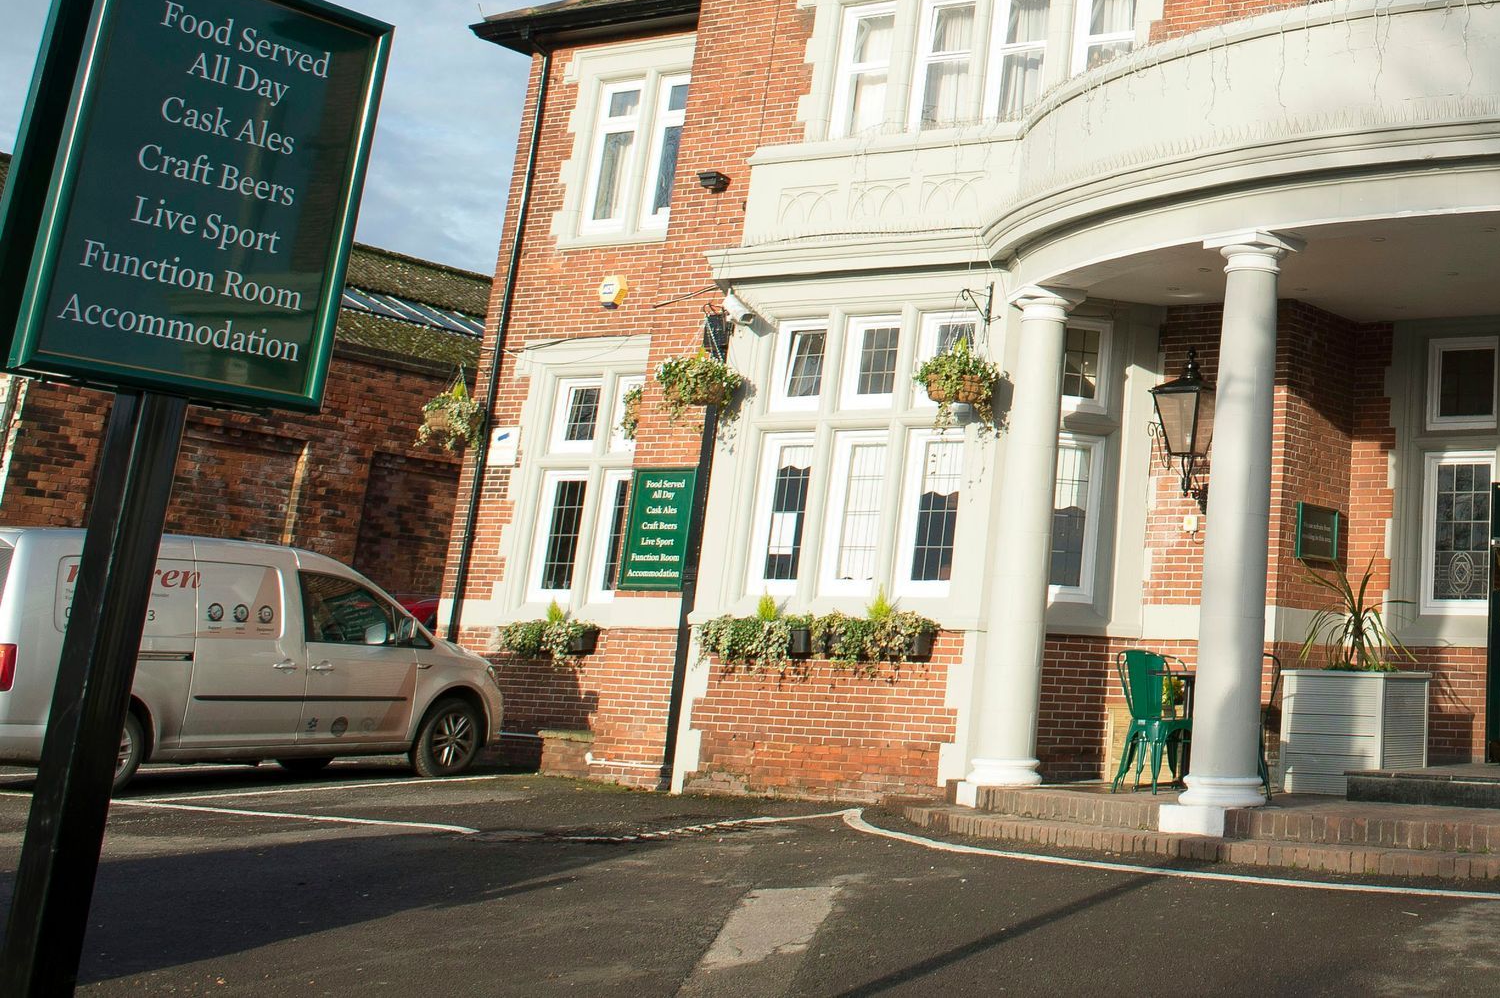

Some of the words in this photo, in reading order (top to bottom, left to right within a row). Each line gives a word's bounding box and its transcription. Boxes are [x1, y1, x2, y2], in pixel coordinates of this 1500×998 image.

[160, 0, 234, 46] Food
[239, 27, 331, 78] Served
[187, 52, 230, 85] All
[234, 64, 290, 107] Day
[161, 96, 232, 138] Cask
[234, 119, 295, 155] Ales
[138, 144, 214, 185] Craft
[217, 163, 295, 206] Beers
[131, 195, 196, 234] Live
[203, 213, 280, 254] Sport
[79, 239, 214, 292] Function
[220, 270, 302, 311] Room
[57, 293, 300, 362] Accommodation
[646, 480, 662, 488] Food
[663, 479, 686, 488] Served
[652, 490, 662, 499] All
[662, 490, 675, 500] Day
[641, 521, 659, 530] Craft
[659, 521, 678, 530] Beers
[646, 506, 661, 514] Cask
[663, 506, 677, 514] Ales
[631, 552, 660, 562] Function
[660, 553, 680, 562] Room
[641, 537, 655, 546] Live
[656, 537, 674, 547] Sport
[627, 569, 680, 578] Accommodation
